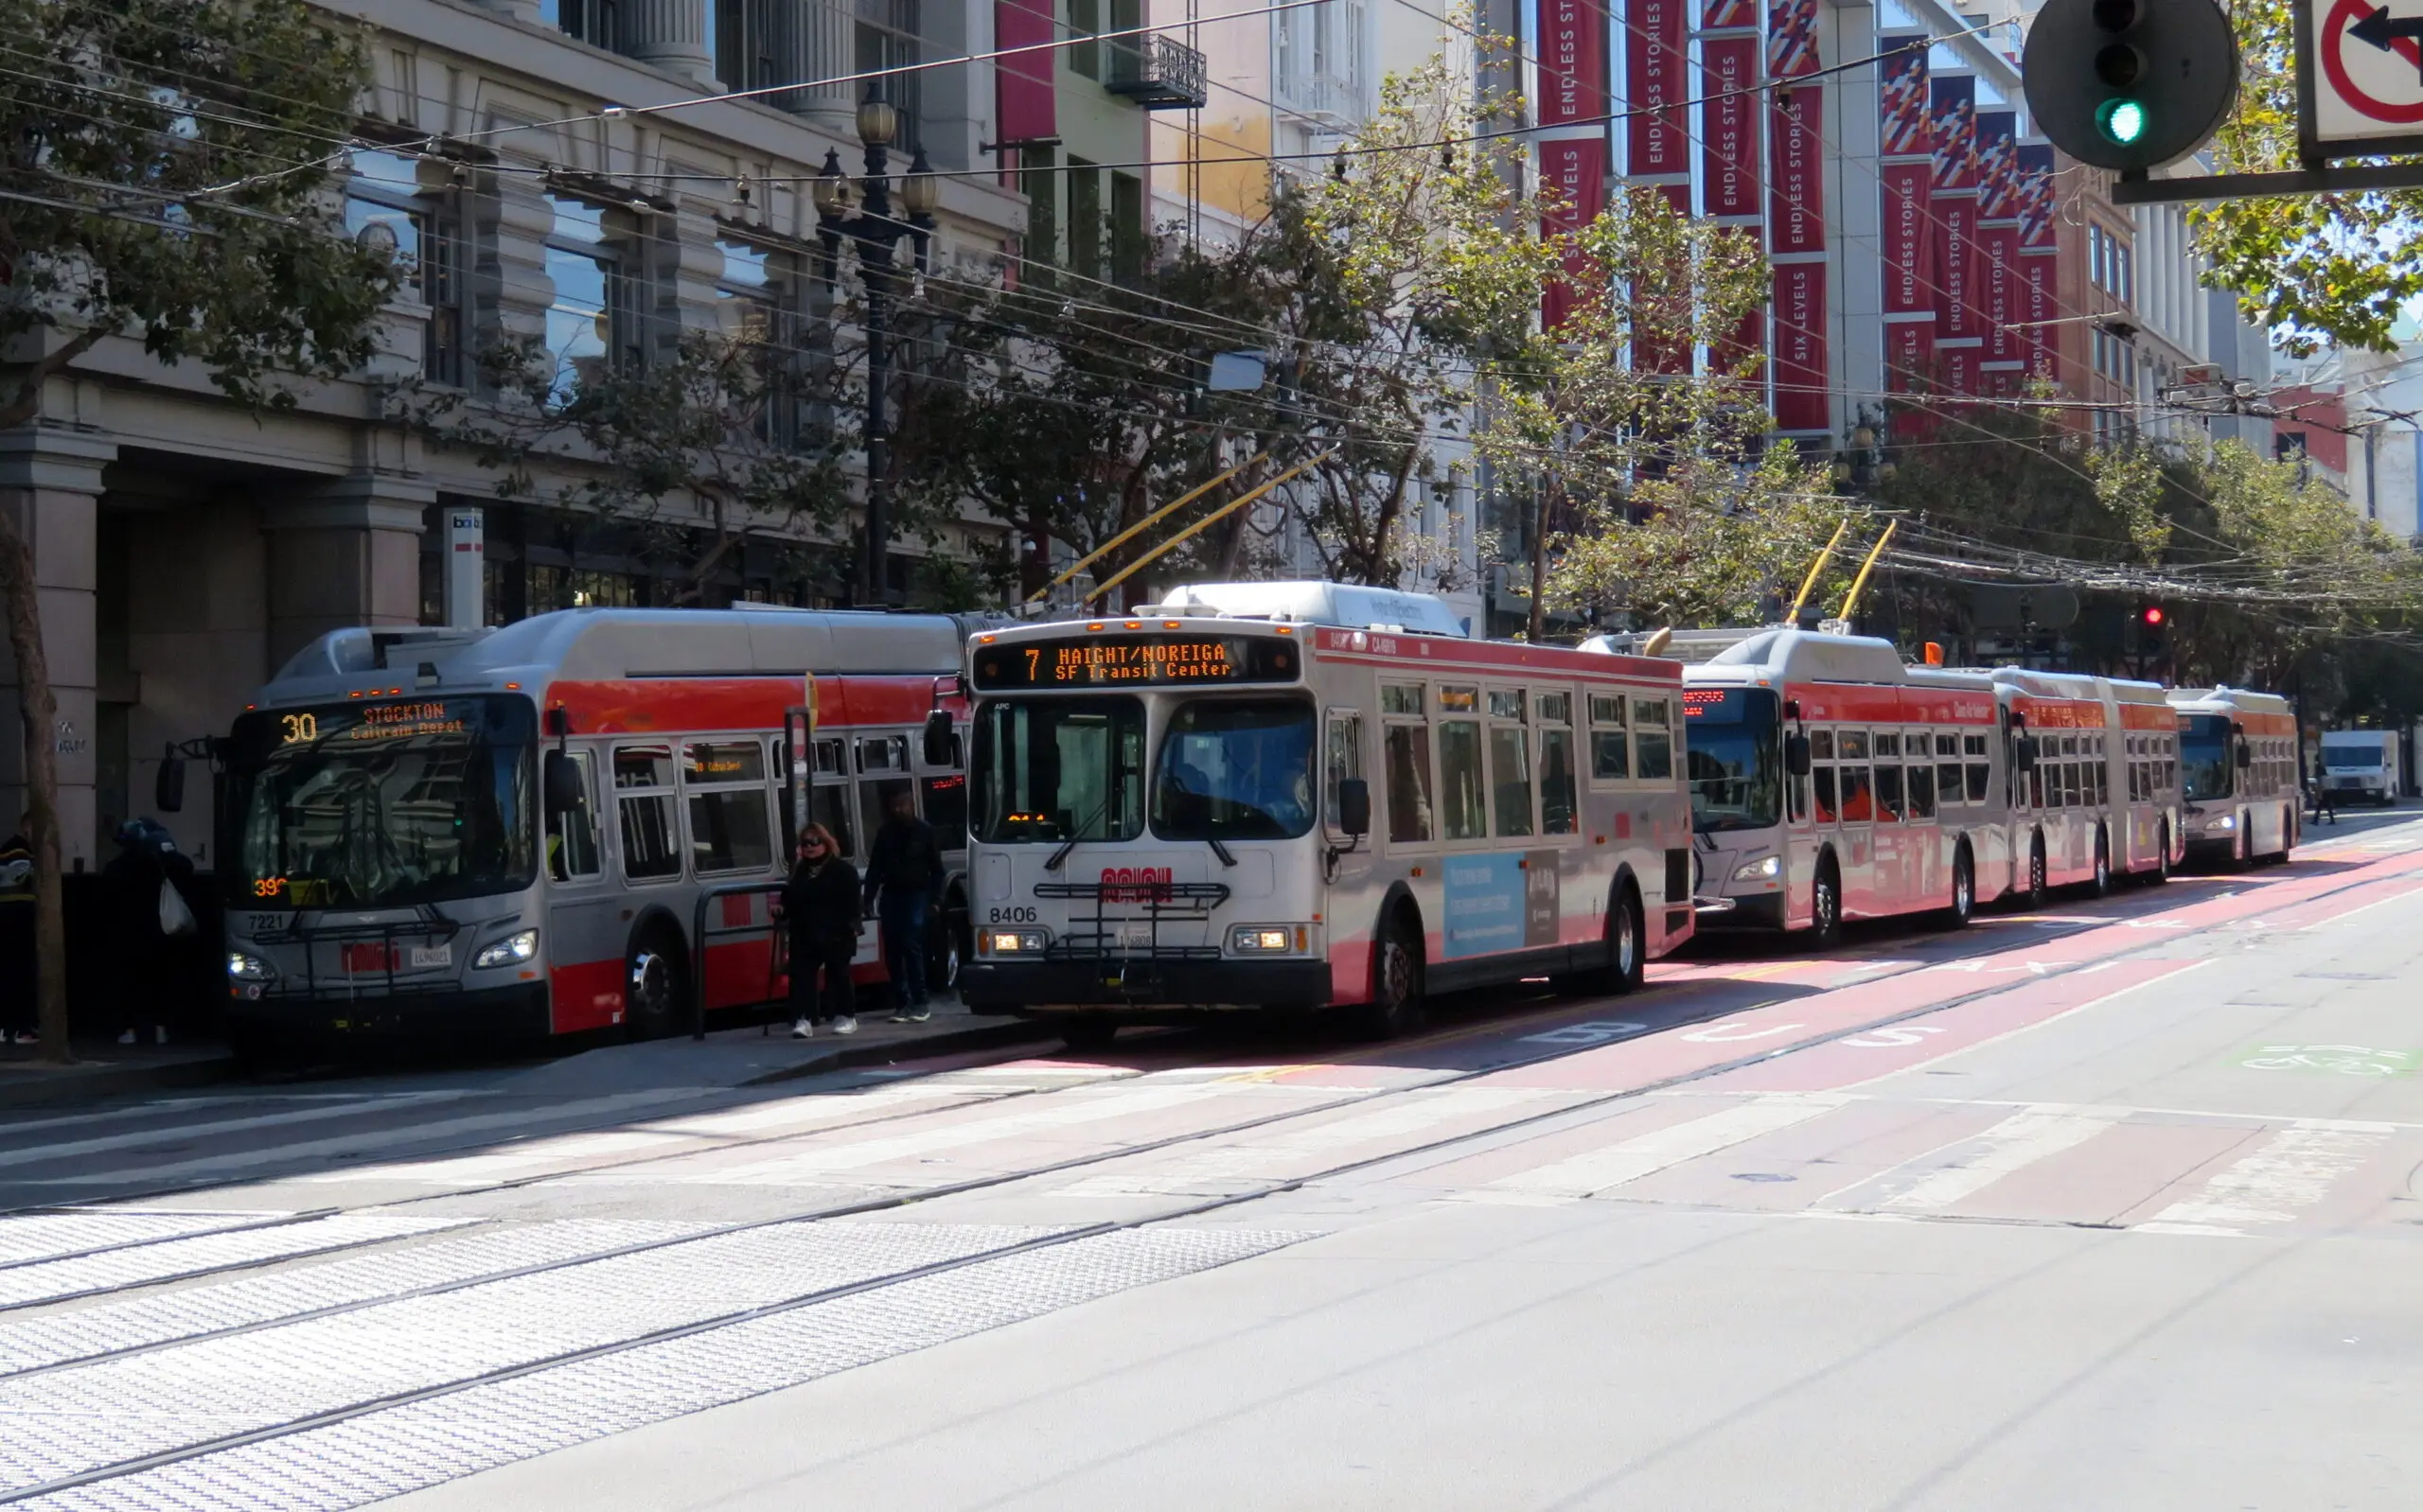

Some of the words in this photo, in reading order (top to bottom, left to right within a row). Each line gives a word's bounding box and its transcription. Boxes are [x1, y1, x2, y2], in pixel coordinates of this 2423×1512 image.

[1647, 2, 1661, 78] STORIES
[1561, 29, 1576, 115] ENDLESS
[1723, 55, 1736, 125] STORIES
[1649, 83, 1663, 164] ENDLSS
[1789, 102, 1802, 168] STORIES
[1564, 149, 1579, 220] LEVELS
[1724, 132, 1737, 206] ENDLESS
[1790, 173, 1804, 244] ENDLESS
[1901, 177, 1913, 238] STORIES
[1949, 211, 1961, 266] STORIES
[1992, 240, 2003, 293] STORIES
[1793, 271, 1806, 330] LEVELS
[1902, 241, 1914, 305] ENDLESS
[1950, 271, 1962, 331] ENDLESS
[2031, 267, 2042, 319] STORIES
[1795, 335, 1807, 360] SIX
[1994, 297, 2005, 354] ENDLESS
[1025, 649, 1039, 680] 7
[1059, 644, 1226, 665] HAIGHT/NOREIGA
[1055, 666, 1076, 680] SF
[1088, 664, 1158, 679] Transit
[1166, 662, 1230, 678] Center
[282, 713, 317, 743] 30
[363, 703, 445, 724] STOCKTON
[248, 915, 283, 929] 7221
[990, 906, 1037, 923] 8406
